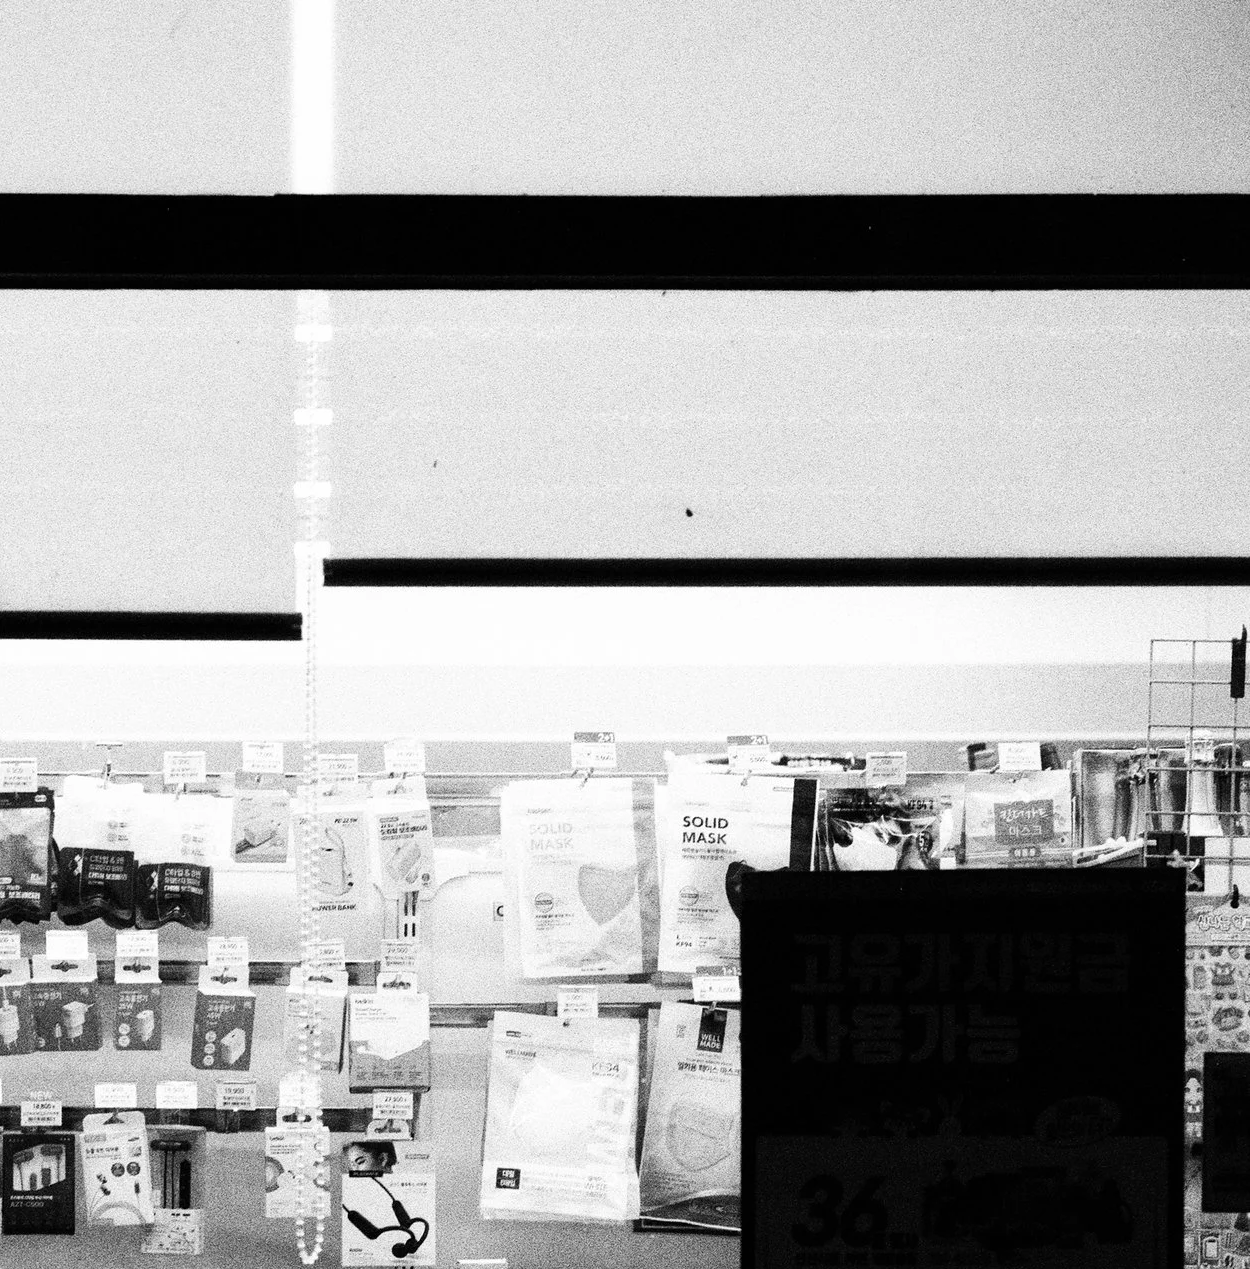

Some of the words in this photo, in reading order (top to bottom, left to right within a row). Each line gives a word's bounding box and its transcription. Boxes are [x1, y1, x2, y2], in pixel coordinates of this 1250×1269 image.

[597, 732, 615, 743] 2+1
[750, 735, 768, 745] 2+1
[683, 816, 729, 830] SOLID
[682, 832, 728, 845] MASK
[791, 930, 1131, 995] 고유가지원금
[701, 1034, 721, 1042] WELL
[791, 1003, 1022, 1064] 사용가능
[700, 1041, 721, 1049] MADE
